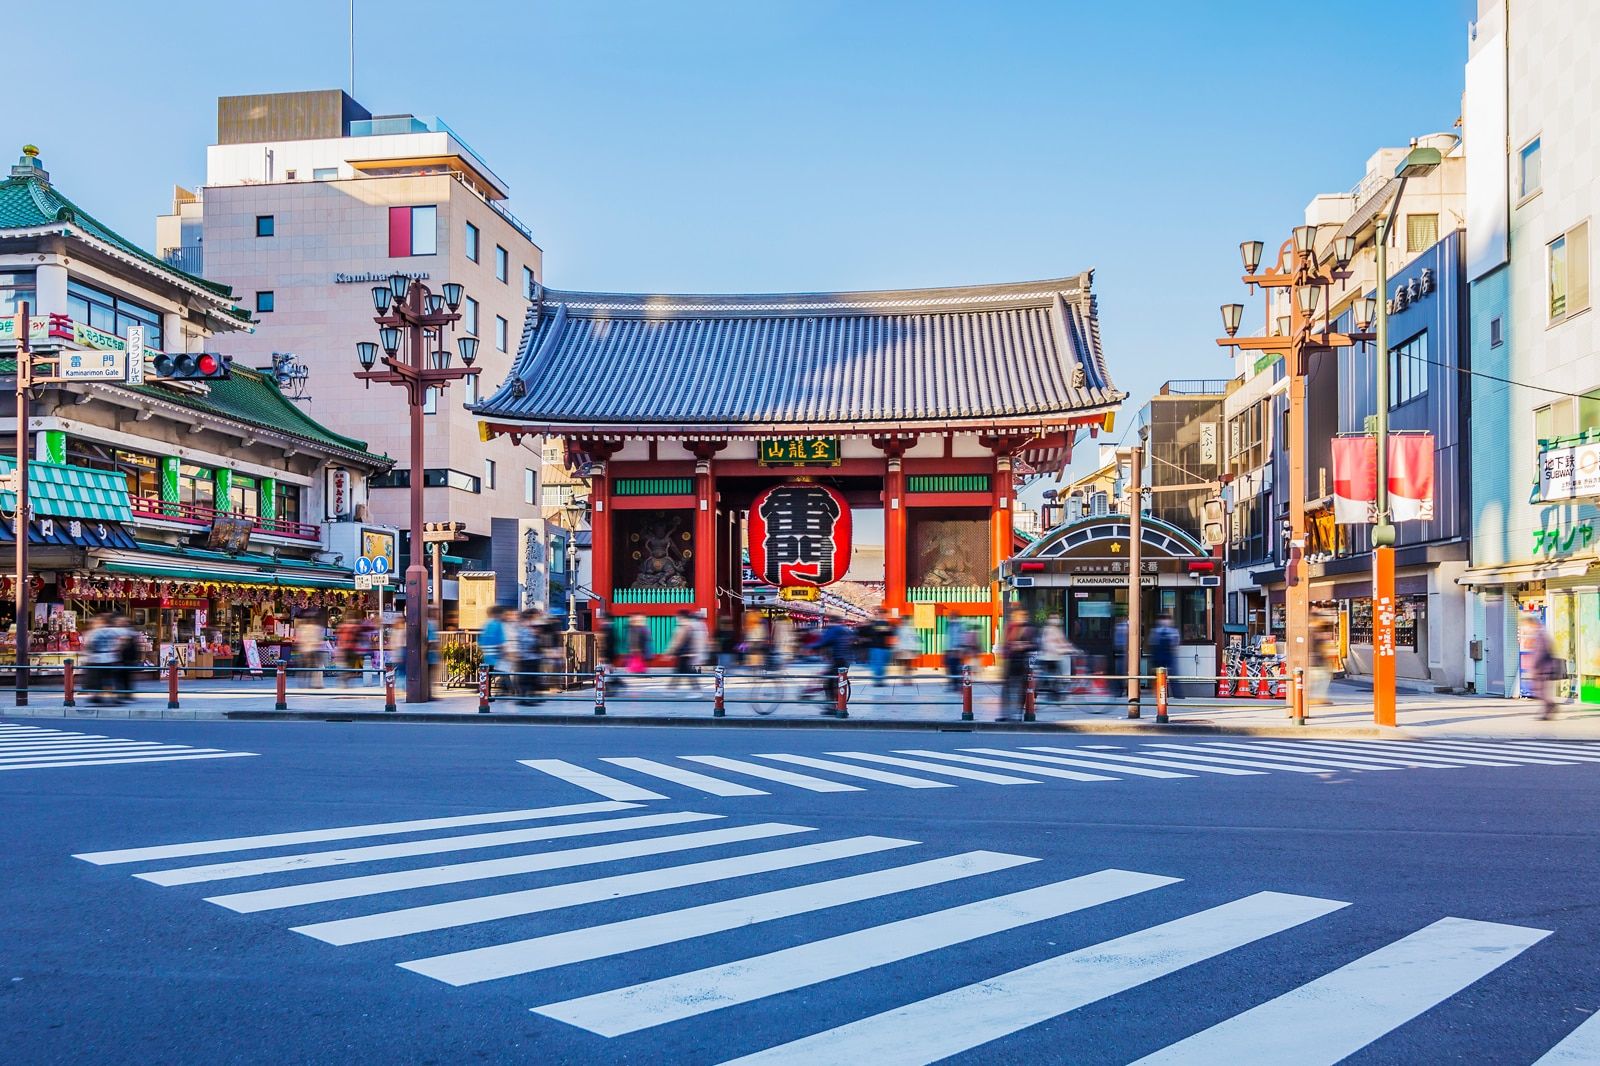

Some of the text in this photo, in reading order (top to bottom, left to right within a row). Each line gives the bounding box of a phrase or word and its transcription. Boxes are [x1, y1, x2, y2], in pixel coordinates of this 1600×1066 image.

[71, 355, 114, 367] 雷門
[131, 330, 140, 382] スクランブル式
[66, 369, 103, 377] Kaminarimon
[1545, 455, 1575, 472] 地下鉄
[1546, 468, 1575, 480] SUBWAY
[1533, 523, 1593, 555] アオノヤ
